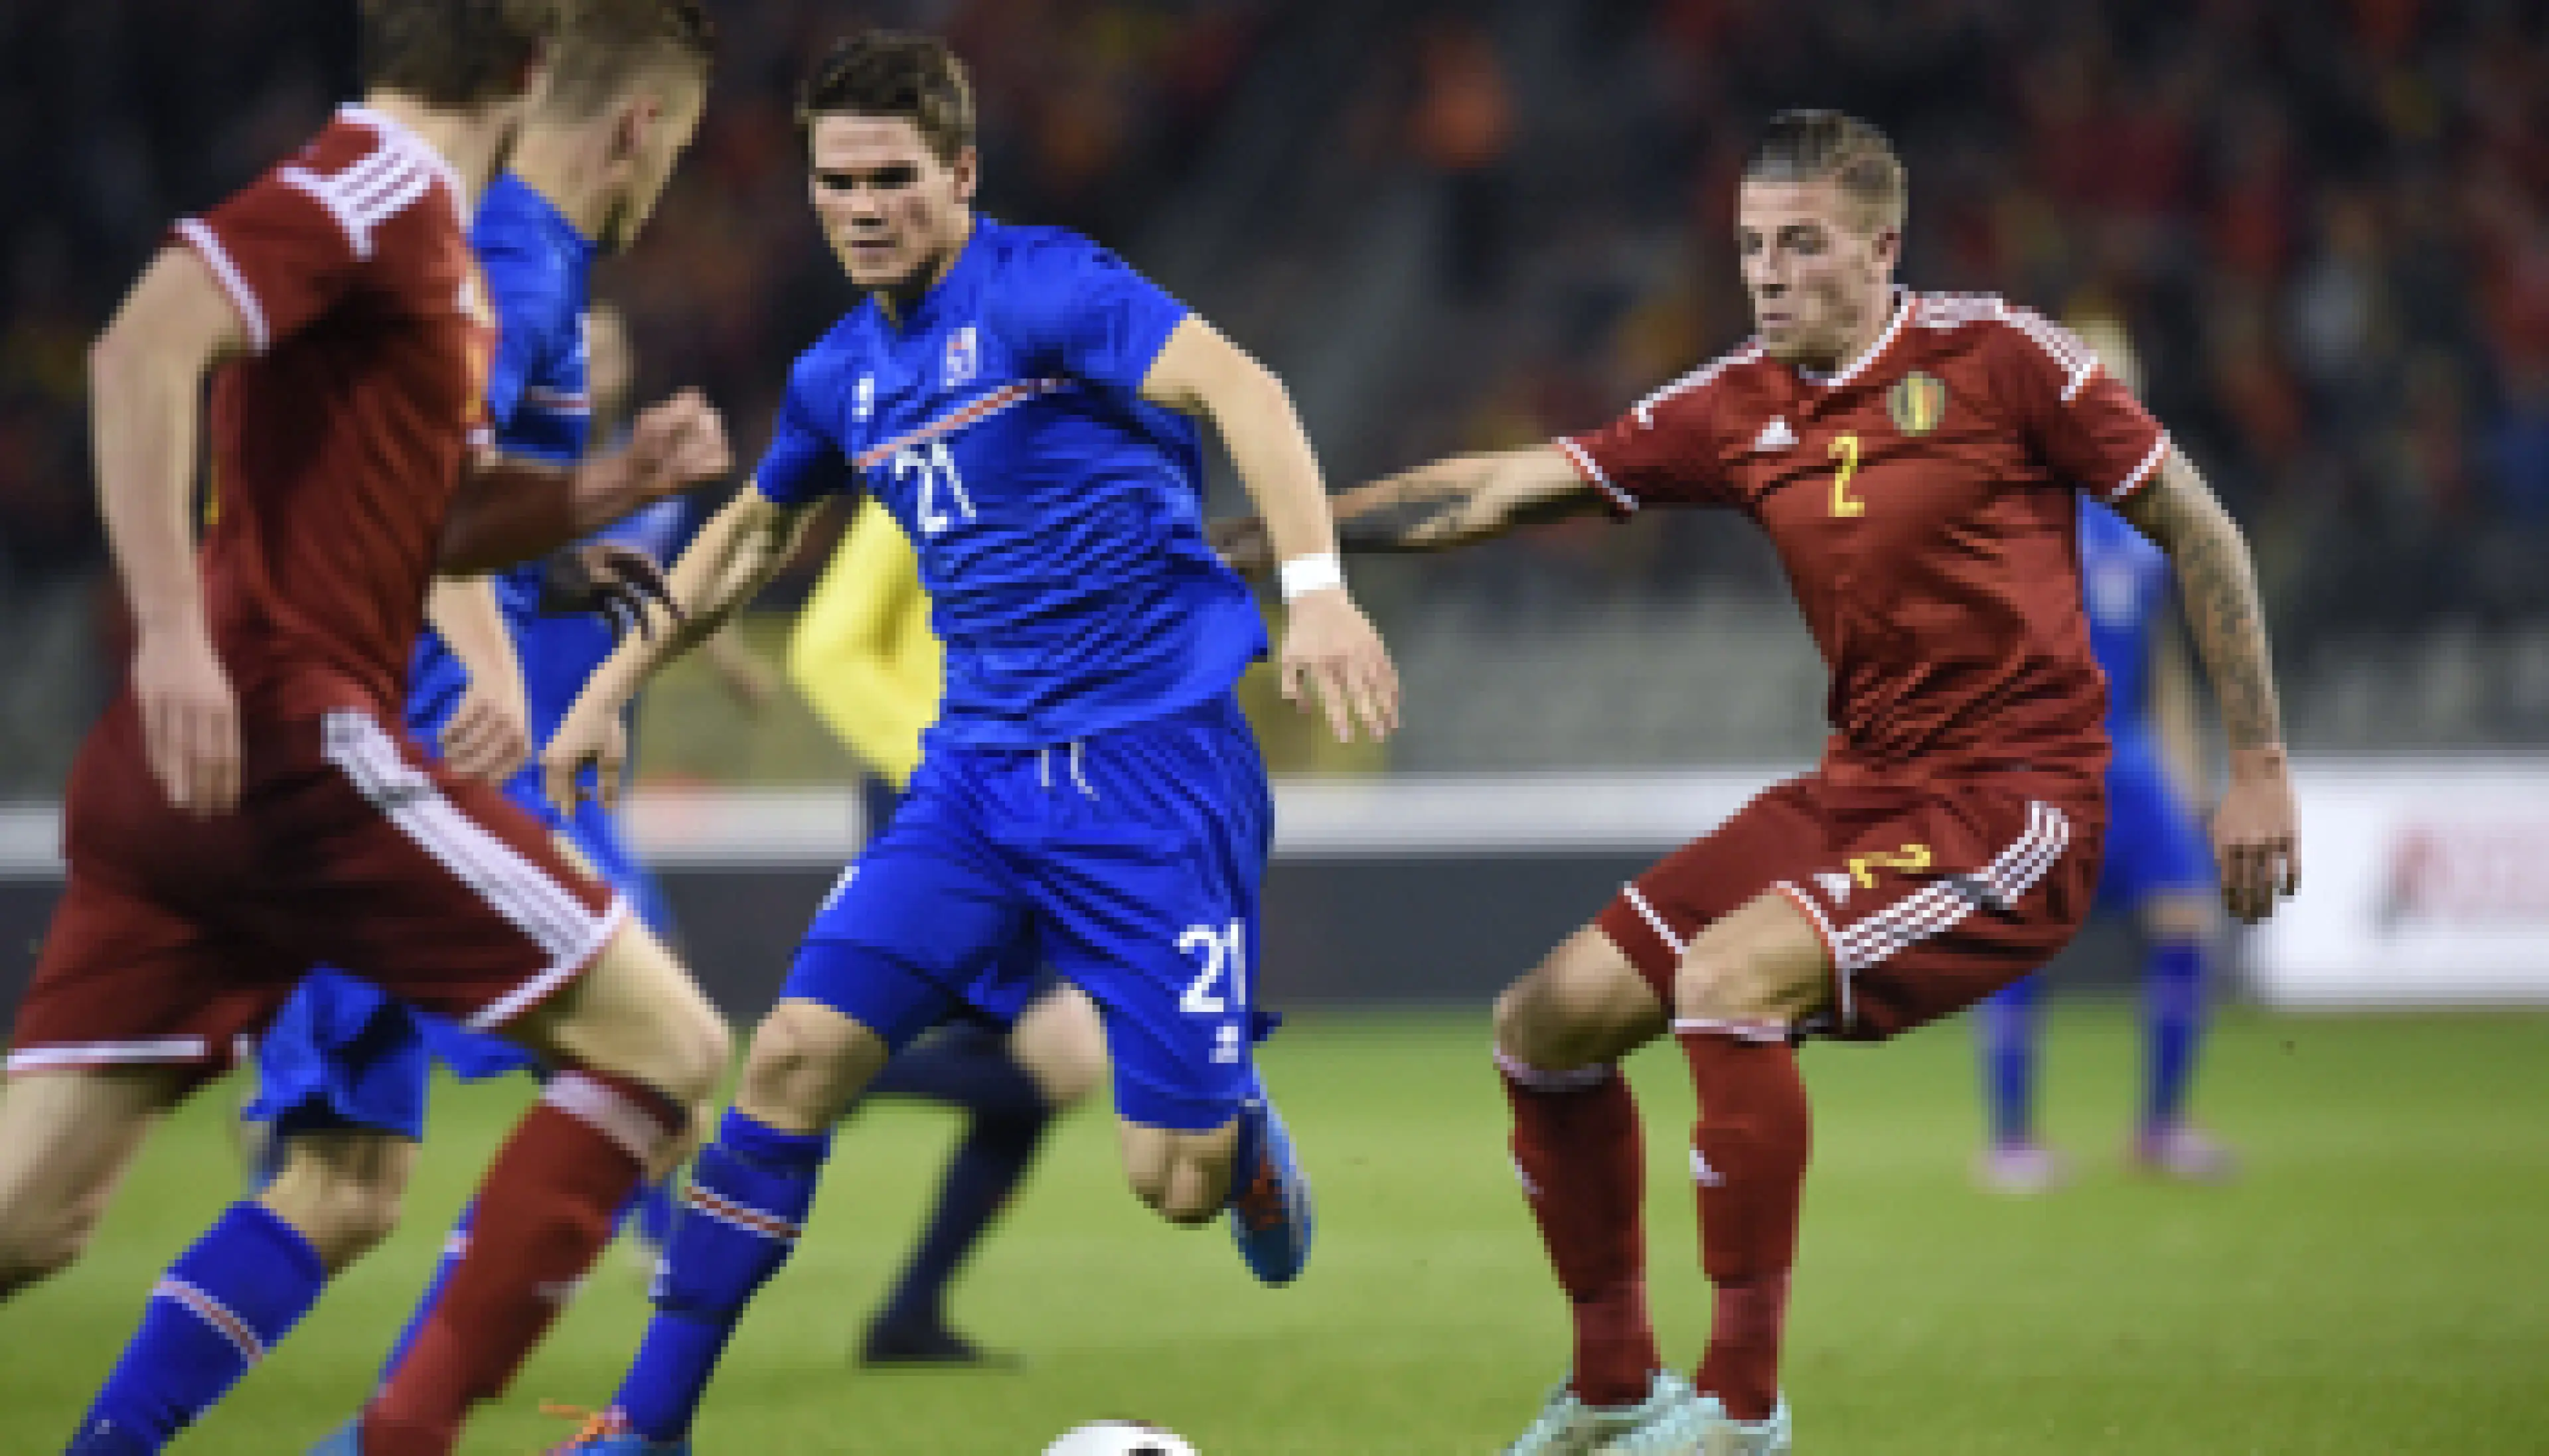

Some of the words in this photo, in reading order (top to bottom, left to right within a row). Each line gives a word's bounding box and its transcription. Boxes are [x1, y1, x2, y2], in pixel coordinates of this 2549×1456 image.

[895, 439, 976, 536] 21
[1828, 433, 1865, 518] 2
[1843, 844, 1930, 888] 2
[1174, 919, 1245, 1012] 21
